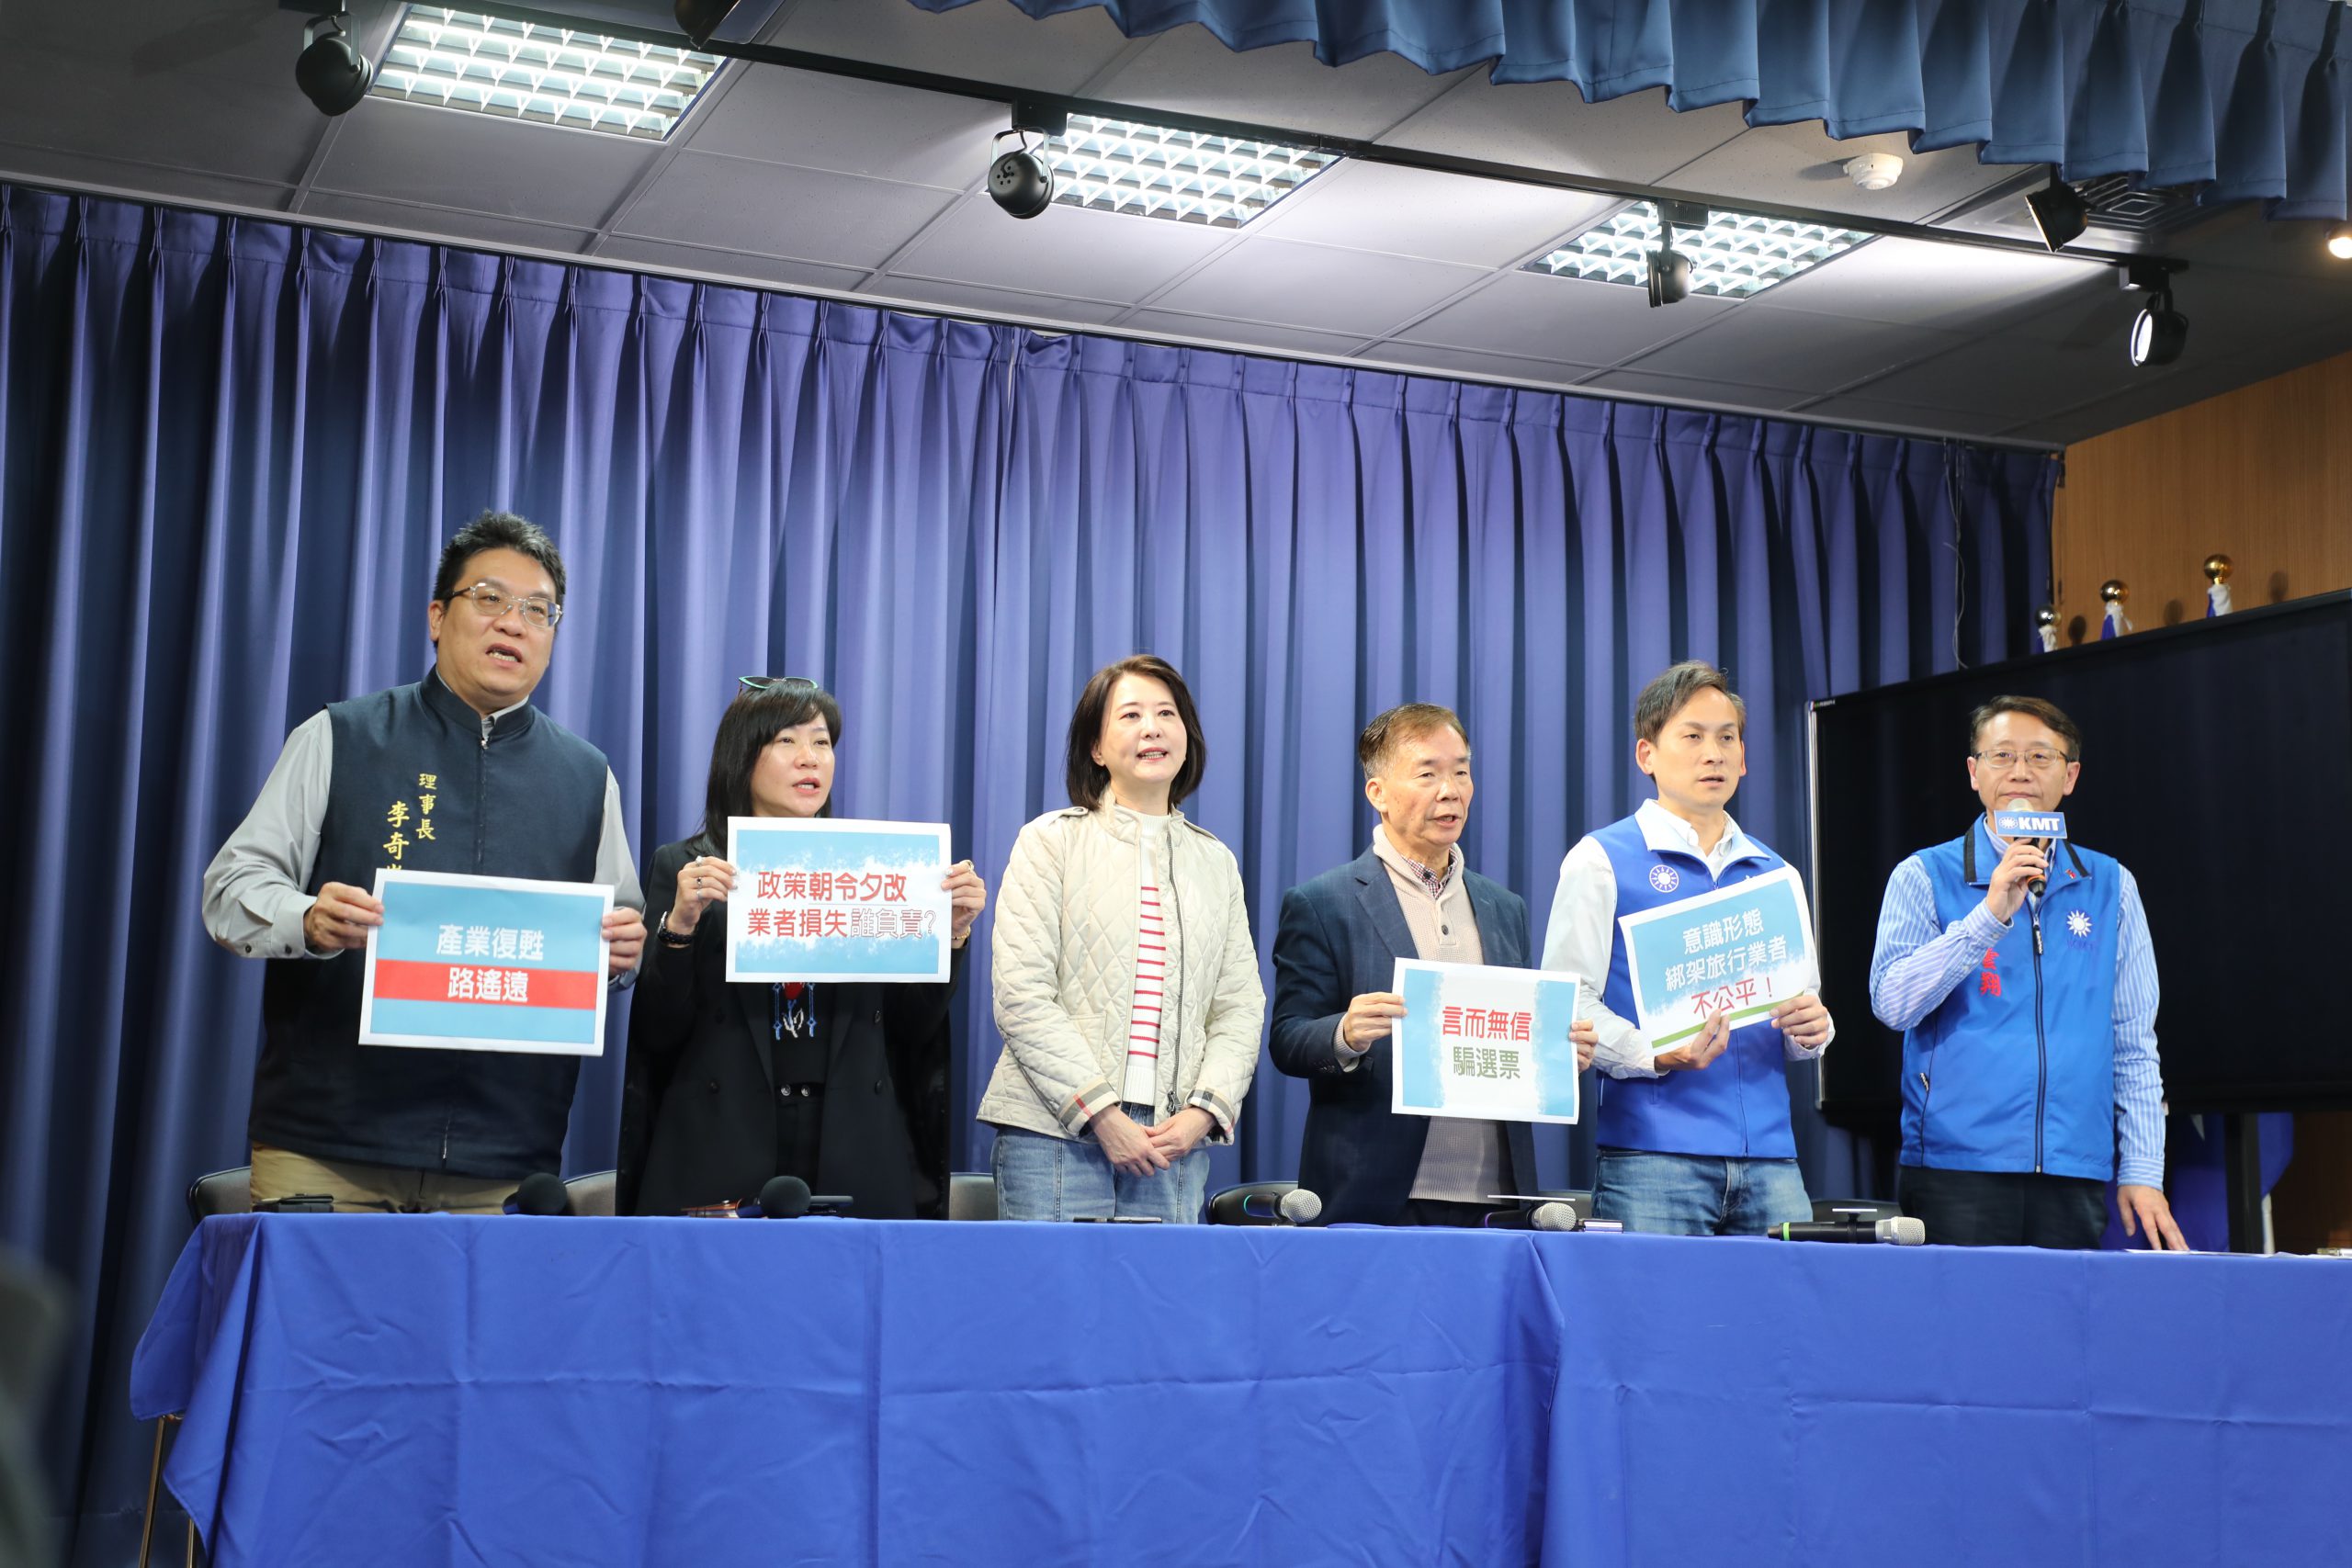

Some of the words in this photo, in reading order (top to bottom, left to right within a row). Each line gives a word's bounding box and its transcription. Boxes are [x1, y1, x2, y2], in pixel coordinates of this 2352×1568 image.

[415, 773, 437, 840] 理事長
[2018, 817, 2060, 831] KMT
[382, 800, 410, 870] 李奇
[757, 871, 908, 902] 政策朝令夕改
[748, 908, 937, 939] 業者損失誰負責?
[1682, 908, 1764, 954] 意識形態
[436, 924, 545, 961] 產業復甦
[1665, 934, 1787, 992] 綁架旅行業者
[447, 966, 529, 1002] 路遙遠
[1442, 1006, 1532, 1042] 言而無信
[1453, 1045, 1521, 1079] 騙選票
